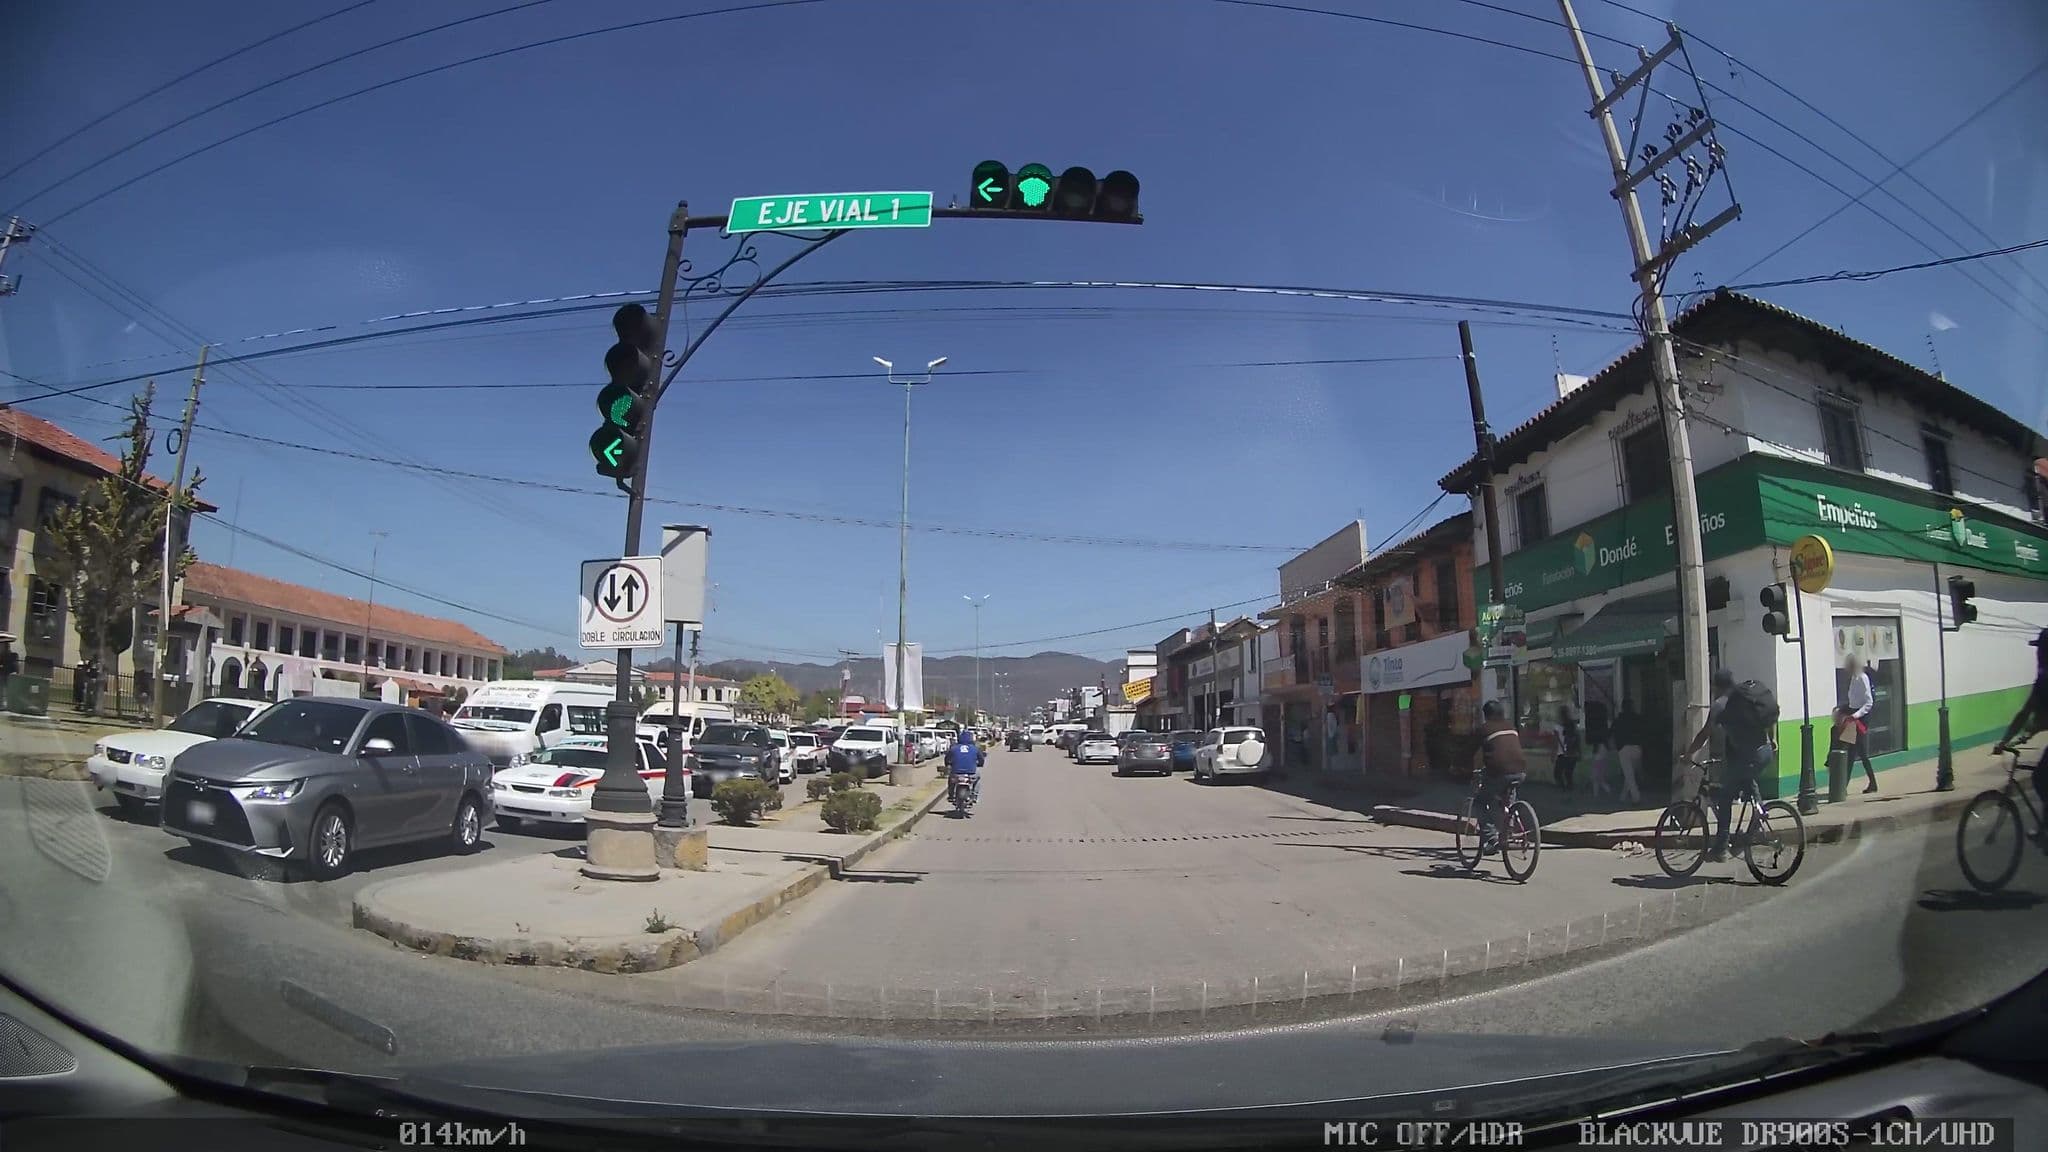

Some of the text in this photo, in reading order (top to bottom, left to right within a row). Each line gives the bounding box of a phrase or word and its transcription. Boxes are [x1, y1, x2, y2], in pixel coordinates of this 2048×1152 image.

[757, 198, 900, 225] EJE VIAL 1
[1664, 513, 1726, 545] Eños
[1817, 494, 1878, 533] Empeños
[1599, 536, 1637, 567] Dondé
[582, 631, 605, 643] DOBLE
